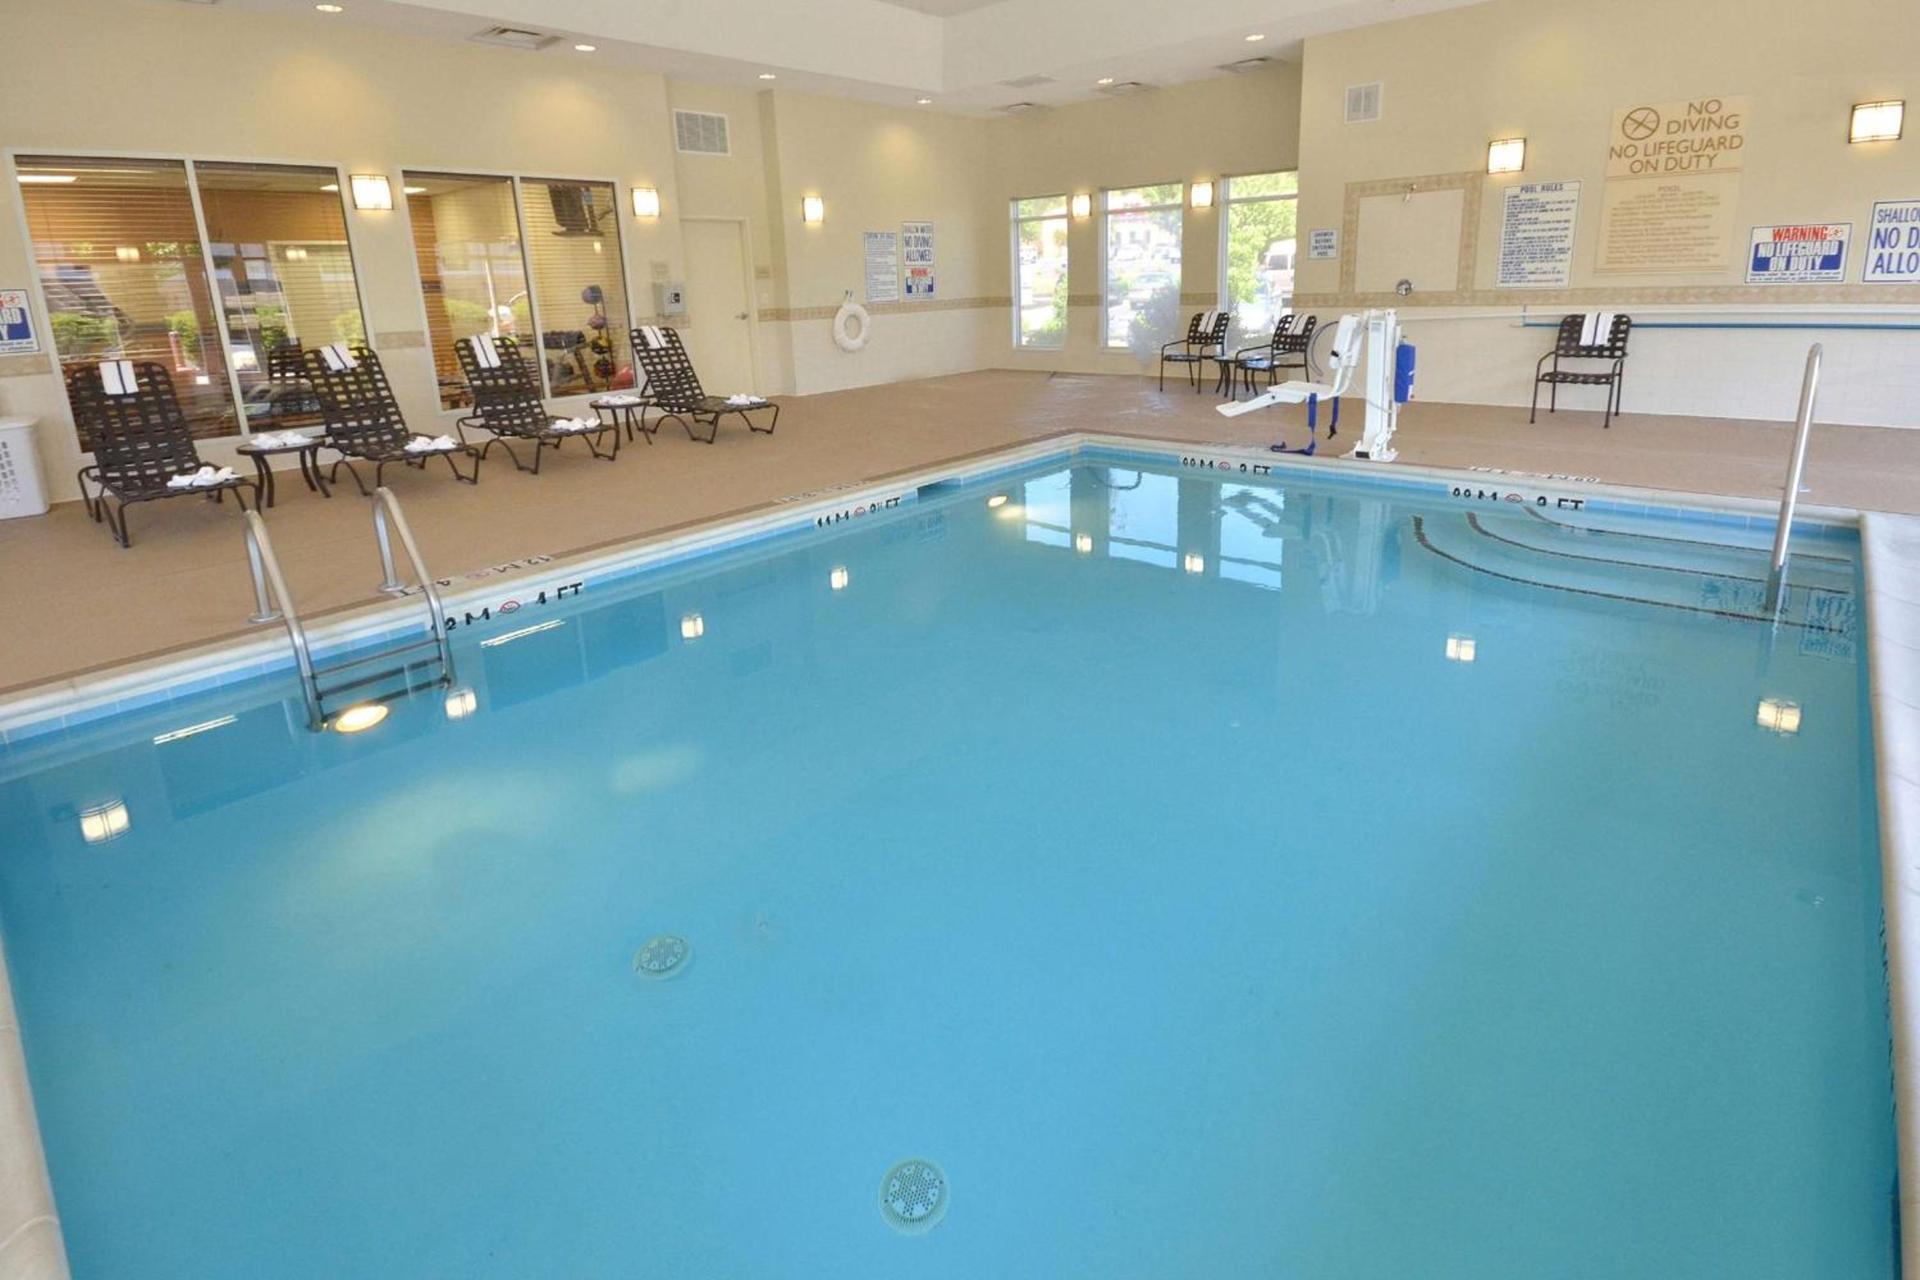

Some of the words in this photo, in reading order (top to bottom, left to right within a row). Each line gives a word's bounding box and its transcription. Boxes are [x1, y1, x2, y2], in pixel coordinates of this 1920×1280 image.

[1687, 99, 1722, 116] NO
[1666, 114, 1740, 135] DIVING
[1609, 144, 1638, 160] NO
[1643, 134, 1743, 157] LIFEGUARD
[1630, 159, 1659, 174] ON
[1664, 153, 1719, 171] DUTY
[1773, 225, 1828, 241] WARNING
[1874, 227, 1900, 249] NO
[1757, 242, 1776, 257] NO
[1777, 240, 1838, 256] LIFEGUARD
[1768, 256, 1787, 271] ON
[1790, 255, 1823, 271] DUTY
[465, 607, 490, 626] M
